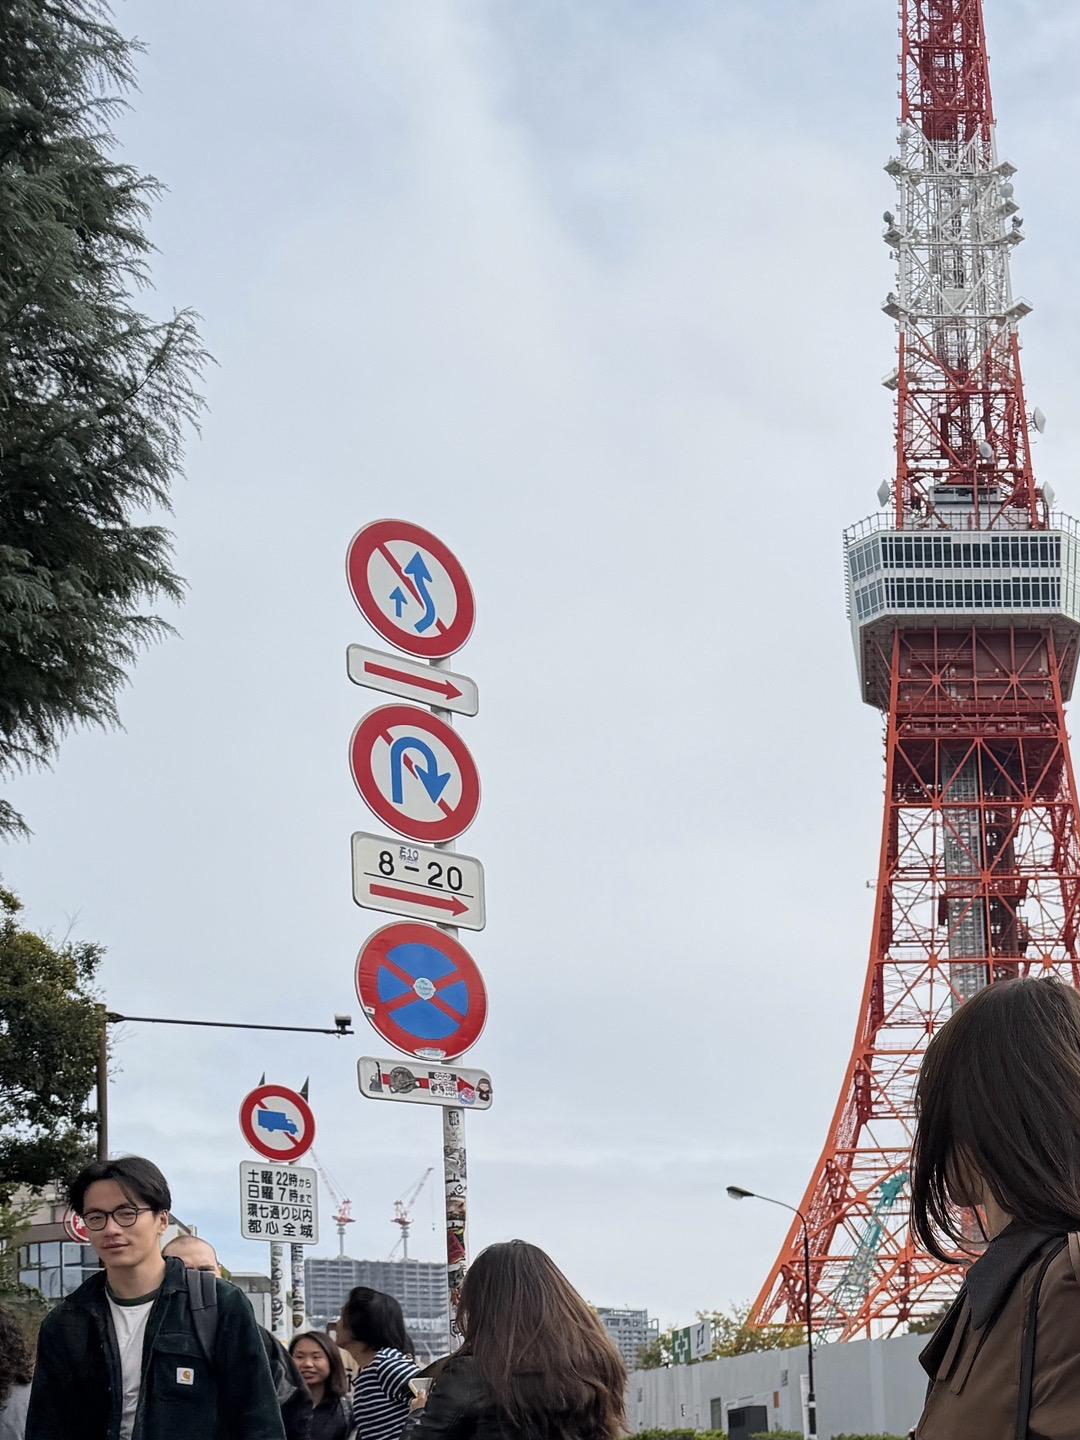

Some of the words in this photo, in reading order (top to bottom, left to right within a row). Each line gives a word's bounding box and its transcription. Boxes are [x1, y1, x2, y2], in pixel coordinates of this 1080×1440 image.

[247, 1169, 312, 1189] 土曜22時から
[248, 1184, 313, 1204] 日曜7時まで
[247, 1203, 313, 1223] 環七通り以内
[247, 1220, 313, 1238] 都心全域
